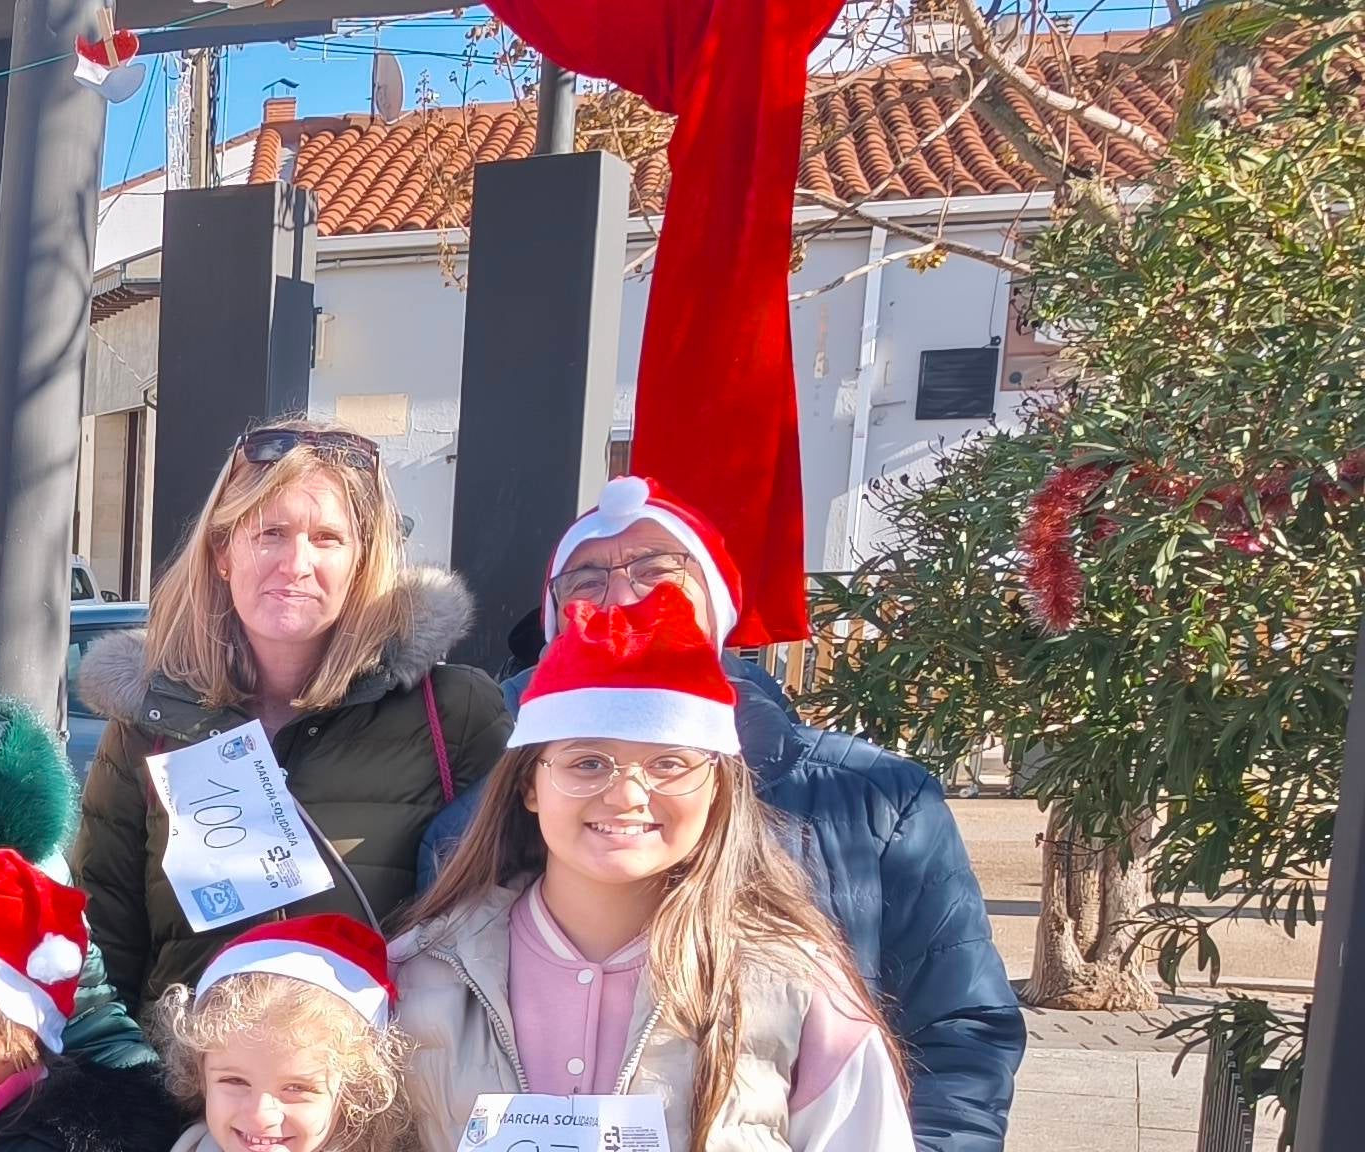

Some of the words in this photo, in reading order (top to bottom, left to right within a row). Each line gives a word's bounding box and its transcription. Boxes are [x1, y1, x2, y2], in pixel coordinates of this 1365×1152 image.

[189, 778, 247, 849] 100
[254, 759, 278, 806] MARCHA
[269, 801, 299, 848] SOLIDARIA
[496, 1113, 550, 1126] MARCHA
[553, 1113, 600, 1128] SOLIDARIA
